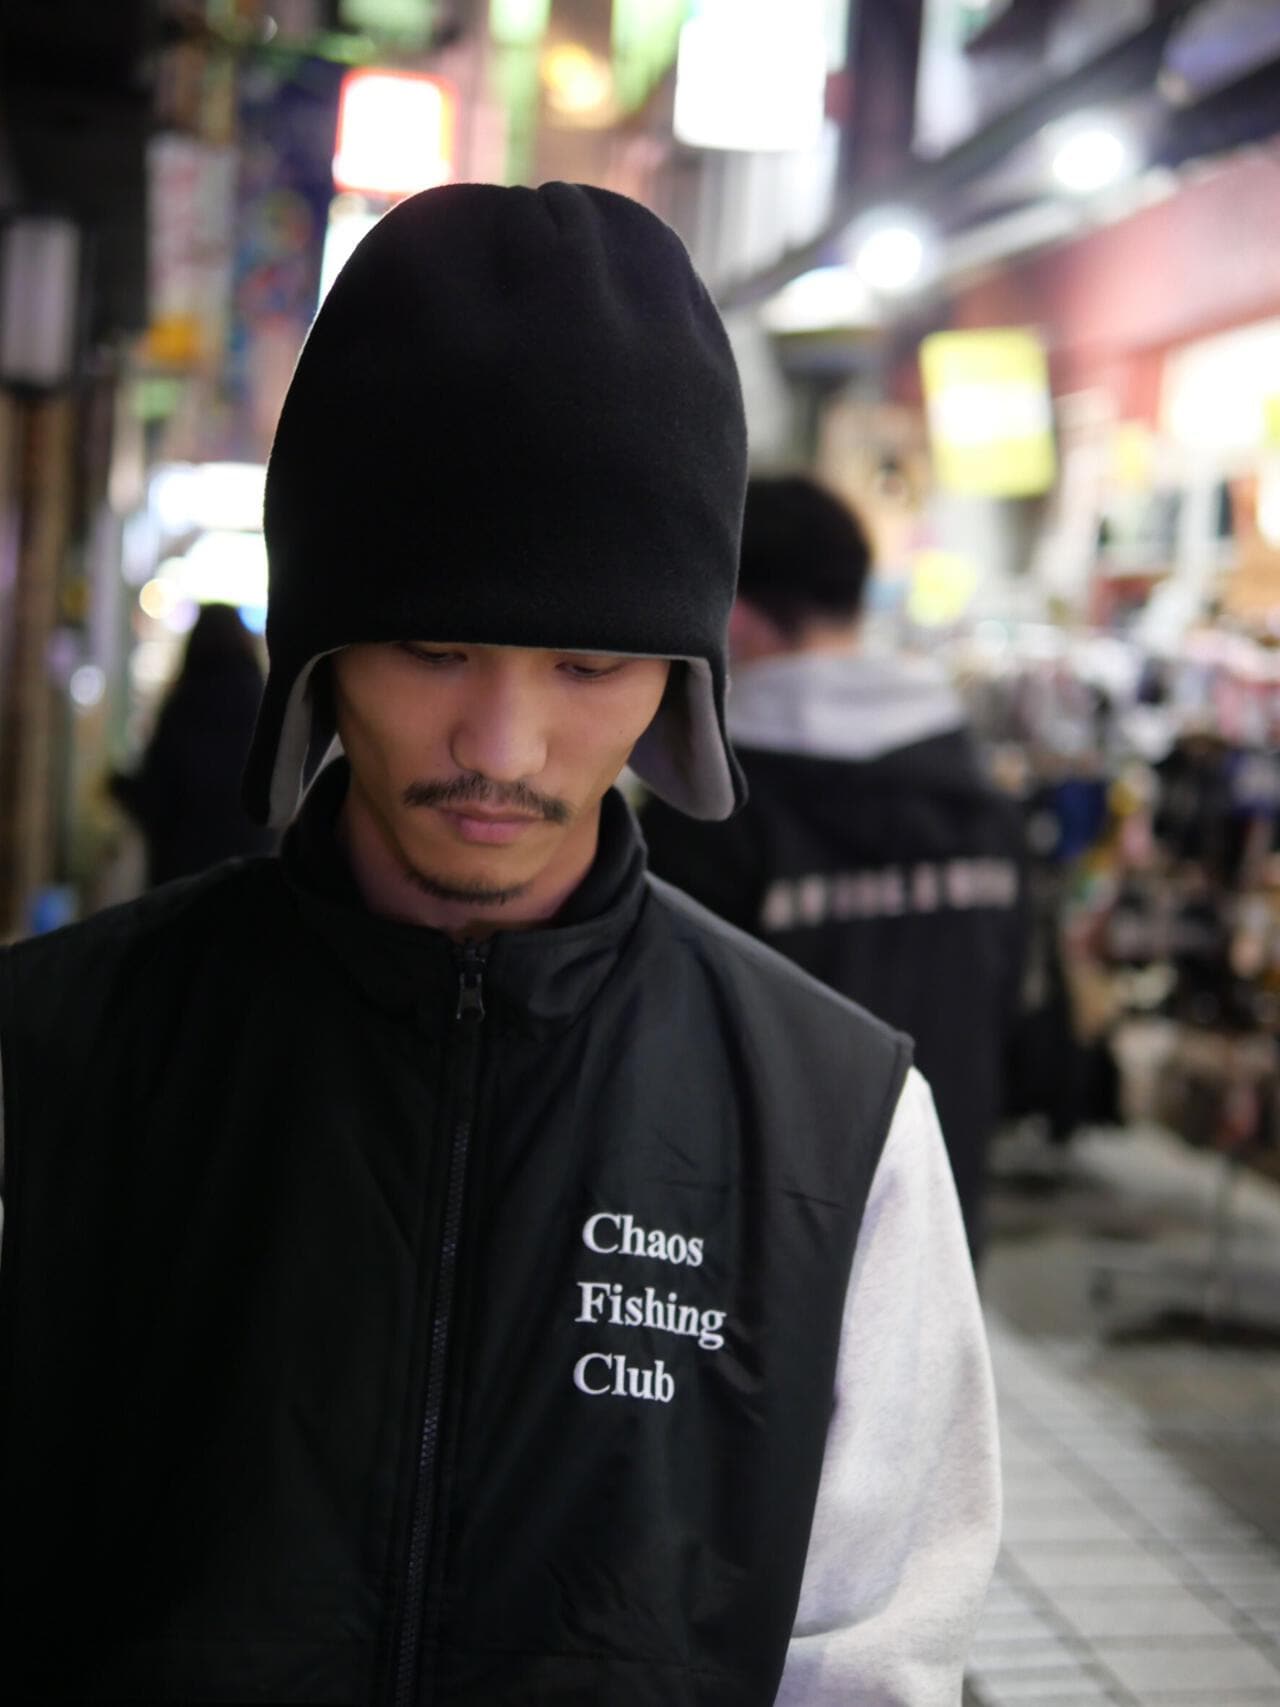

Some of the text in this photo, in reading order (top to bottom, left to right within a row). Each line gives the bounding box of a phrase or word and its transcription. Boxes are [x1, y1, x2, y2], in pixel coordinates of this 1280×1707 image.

[582, 1212, 704, 1267] Chaos
[574, 1281, 727, 1350] Fishing
[573, 1352, 675, 1403] Club
